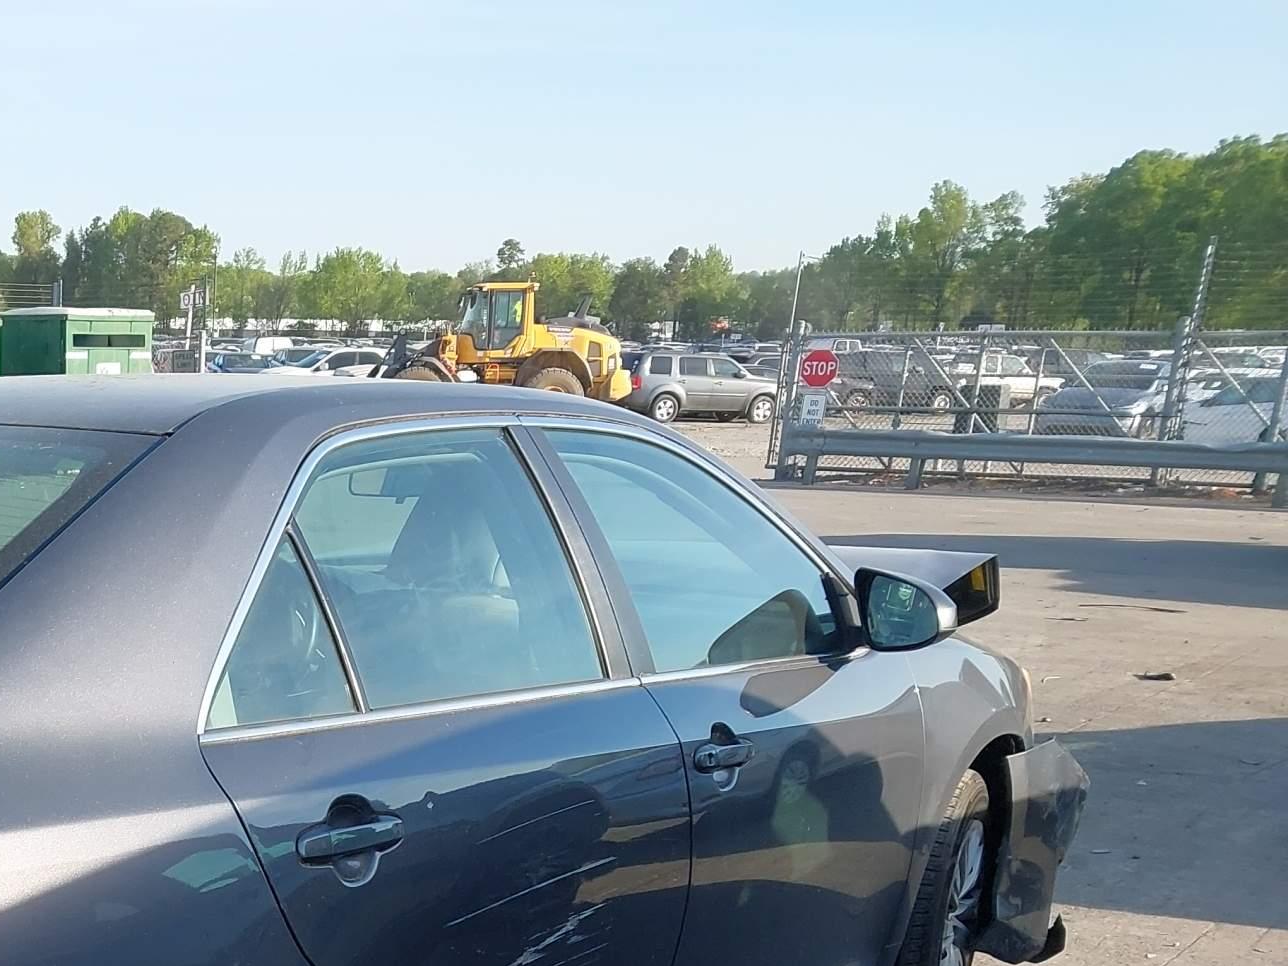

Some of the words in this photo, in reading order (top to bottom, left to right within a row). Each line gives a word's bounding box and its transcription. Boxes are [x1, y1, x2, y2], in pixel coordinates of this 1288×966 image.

[803, 361, 837, 376] STOP
[810, 399, 819, 407] DO
[807, 408, 820, 416] NOT
[802, 417, 823, 425] ENTER
